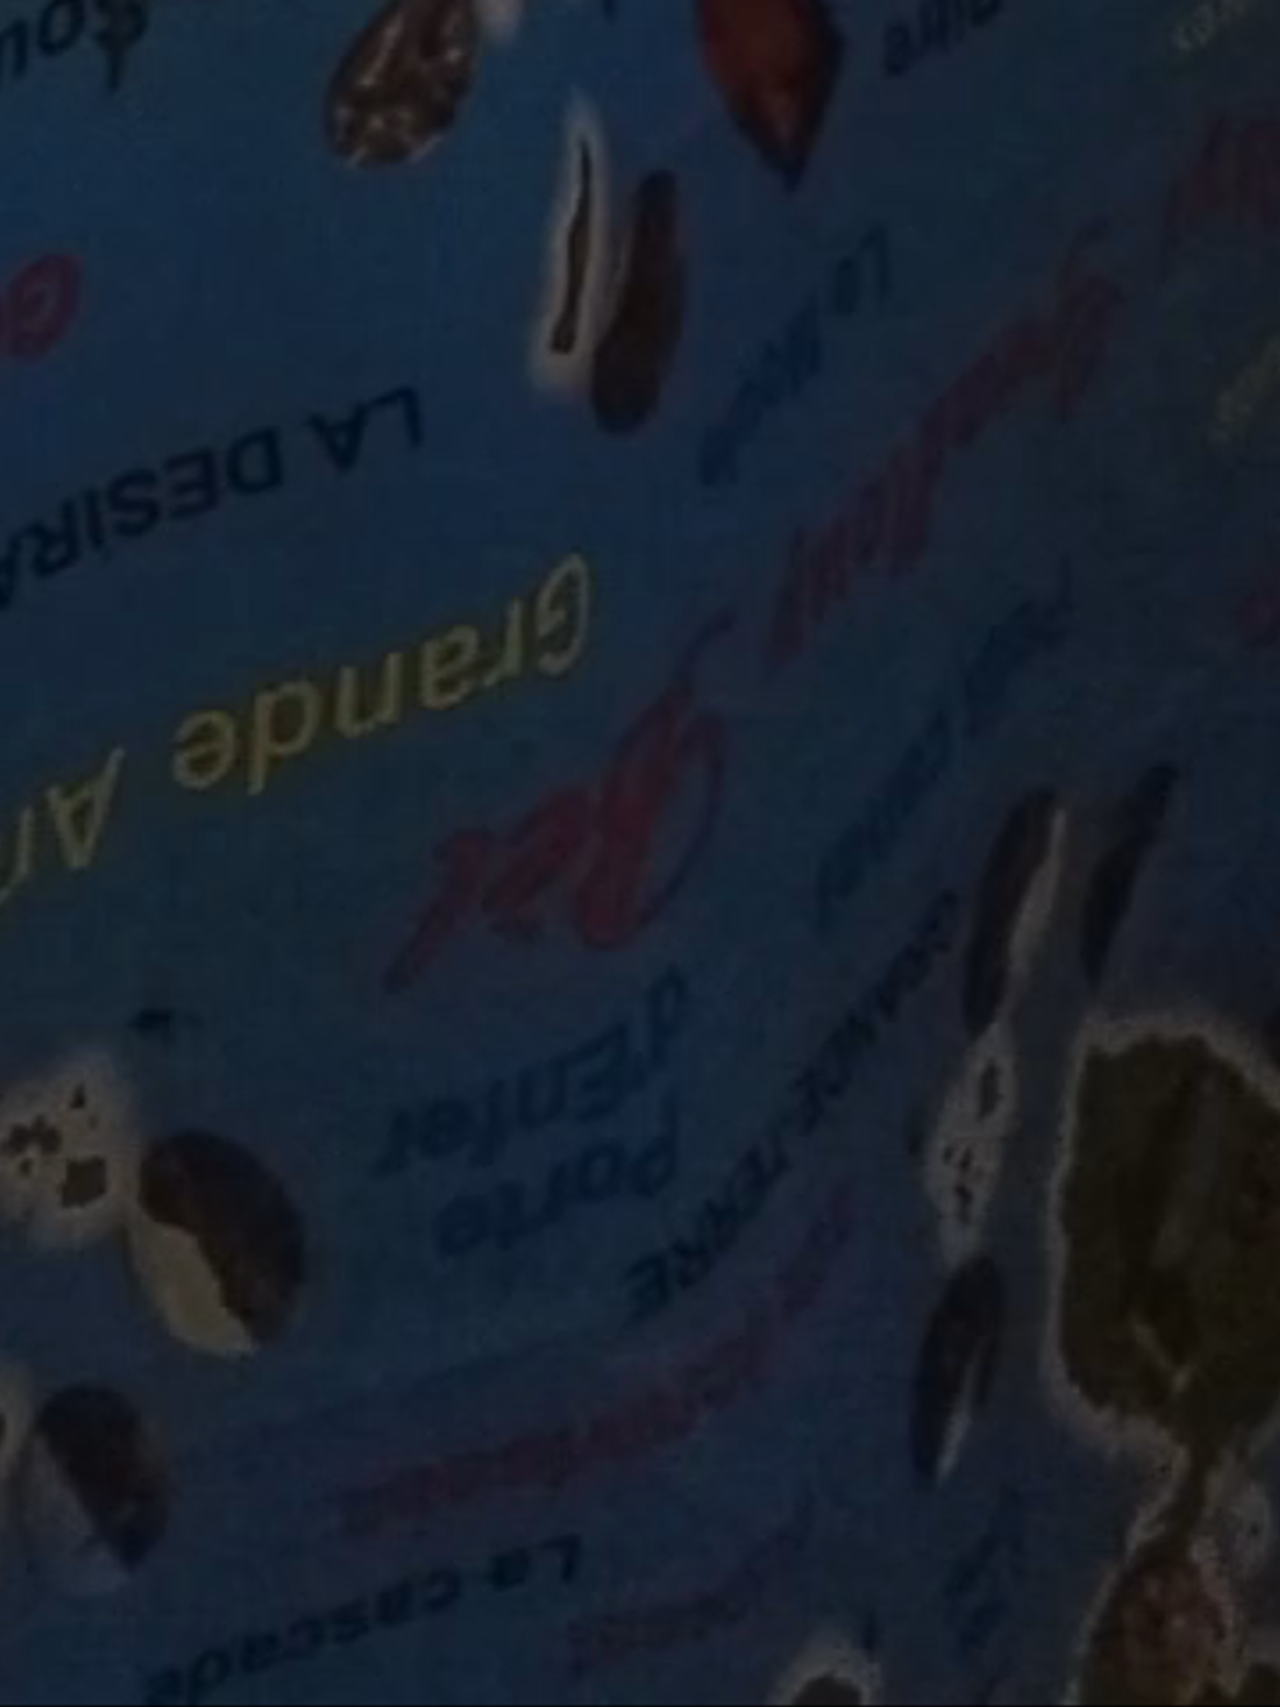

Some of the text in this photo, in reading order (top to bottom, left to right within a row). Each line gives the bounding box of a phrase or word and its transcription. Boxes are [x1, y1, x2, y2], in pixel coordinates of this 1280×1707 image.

[300, 382, 424, 478] LA
[177, 549, 586, 796] Grande
[429, 1092, 674, 1262] Porte
